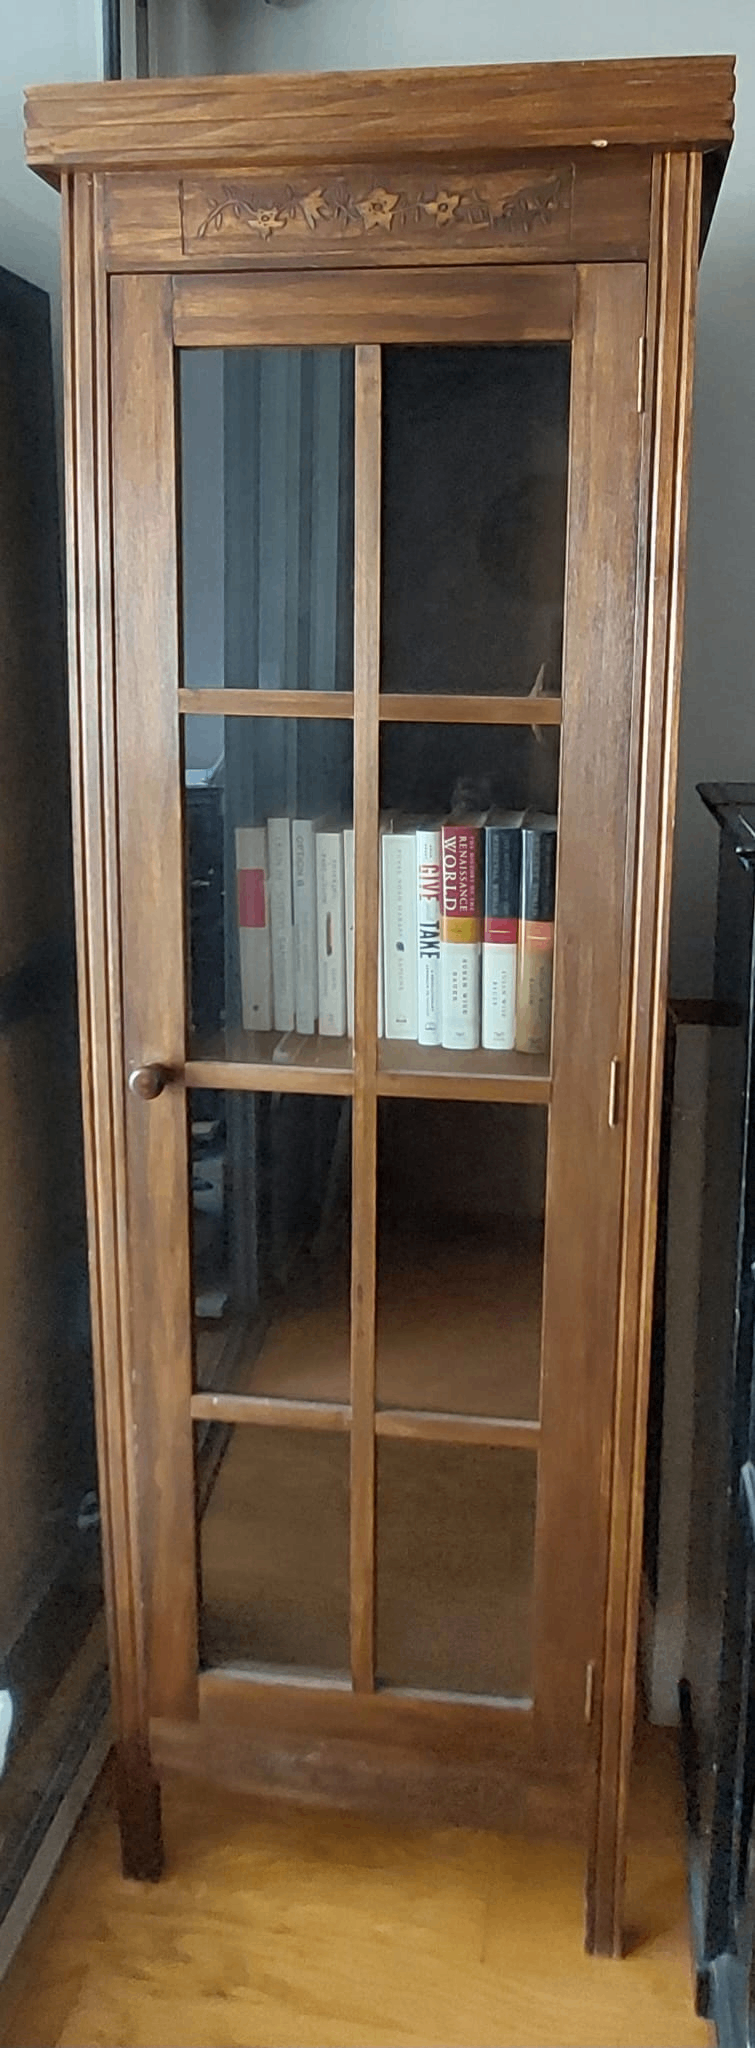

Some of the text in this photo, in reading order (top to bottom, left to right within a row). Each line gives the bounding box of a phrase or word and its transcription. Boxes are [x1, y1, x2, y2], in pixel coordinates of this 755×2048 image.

[296, 835, 305, 876] OPTION
[444, 835, 457, 912] WORLD
[459, 835, 468, 913] RENAISSANCE
[419, 864, 440, 901] GIVE
[419, 920, 440, 960] TAKE
